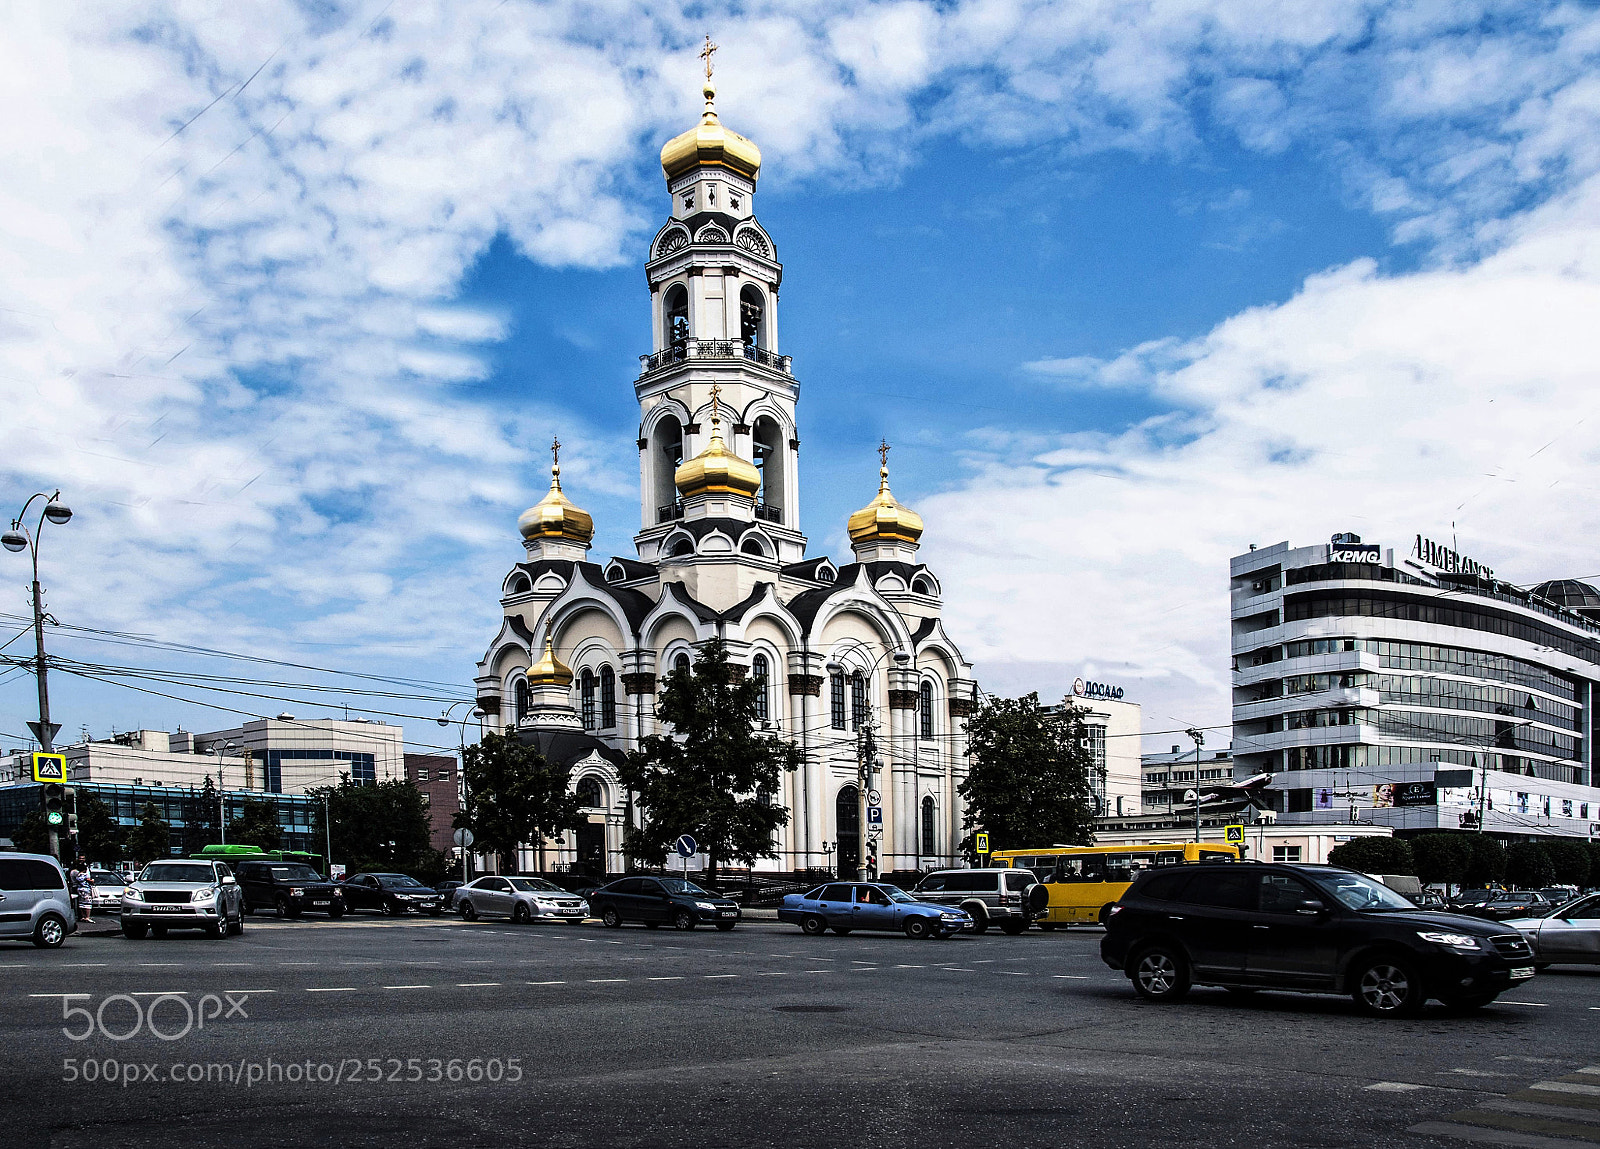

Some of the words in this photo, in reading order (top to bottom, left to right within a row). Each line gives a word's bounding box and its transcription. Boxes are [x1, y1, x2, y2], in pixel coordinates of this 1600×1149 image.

[1331, 550, 1379, 563] KPMG
[1084, 681, 1124, 699] ДОСААФ
[870, 808, 880, 822] P
